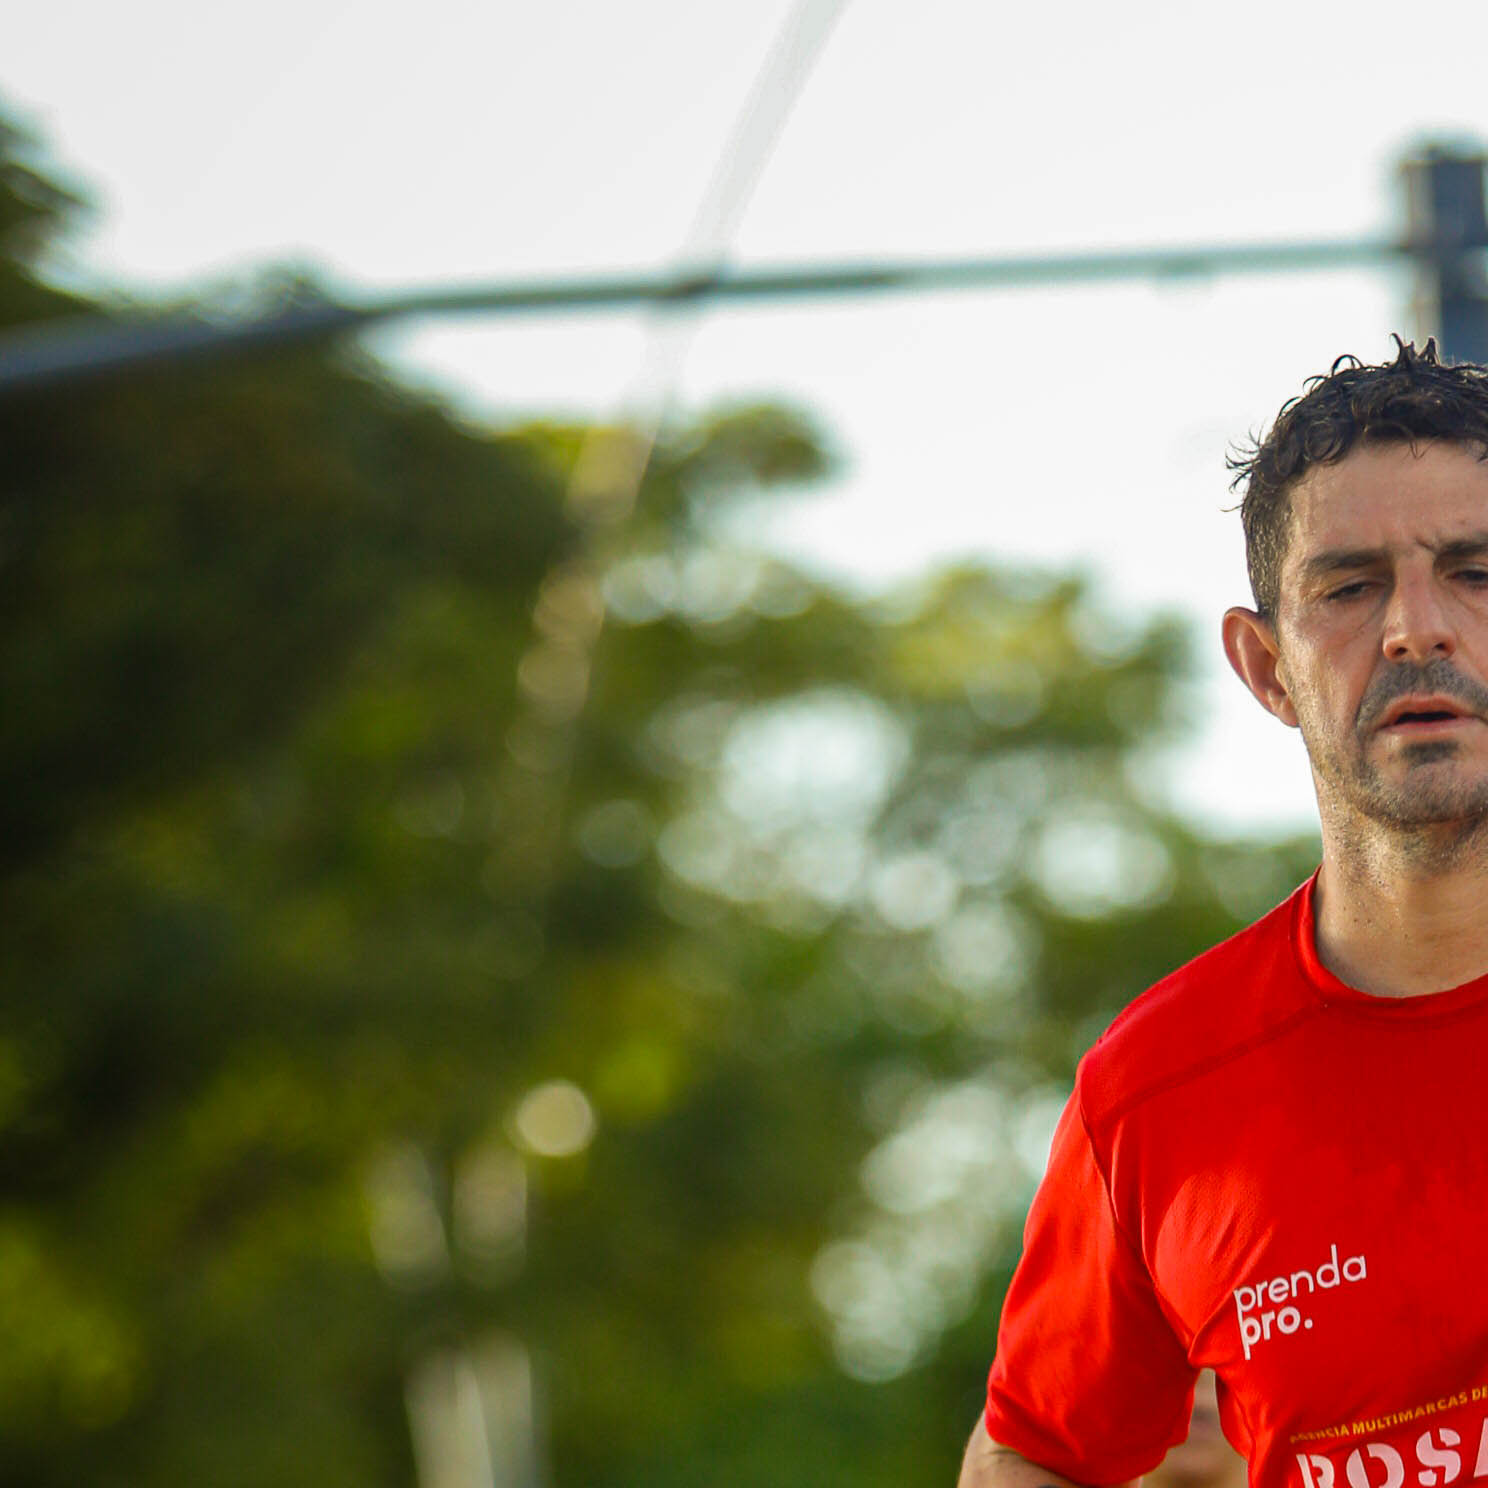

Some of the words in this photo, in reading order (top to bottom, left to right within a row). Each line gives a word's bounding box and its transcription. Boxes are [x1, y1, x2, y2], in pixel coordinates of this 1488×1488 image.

[1233, 1243, 1367, 1318] prenda
[1240, 1306, 1314, 1361] pro.
[1351, 1391, 1469, 1436] MULTIMARCAS
[1471, 1385, 1488, 1402] DE
